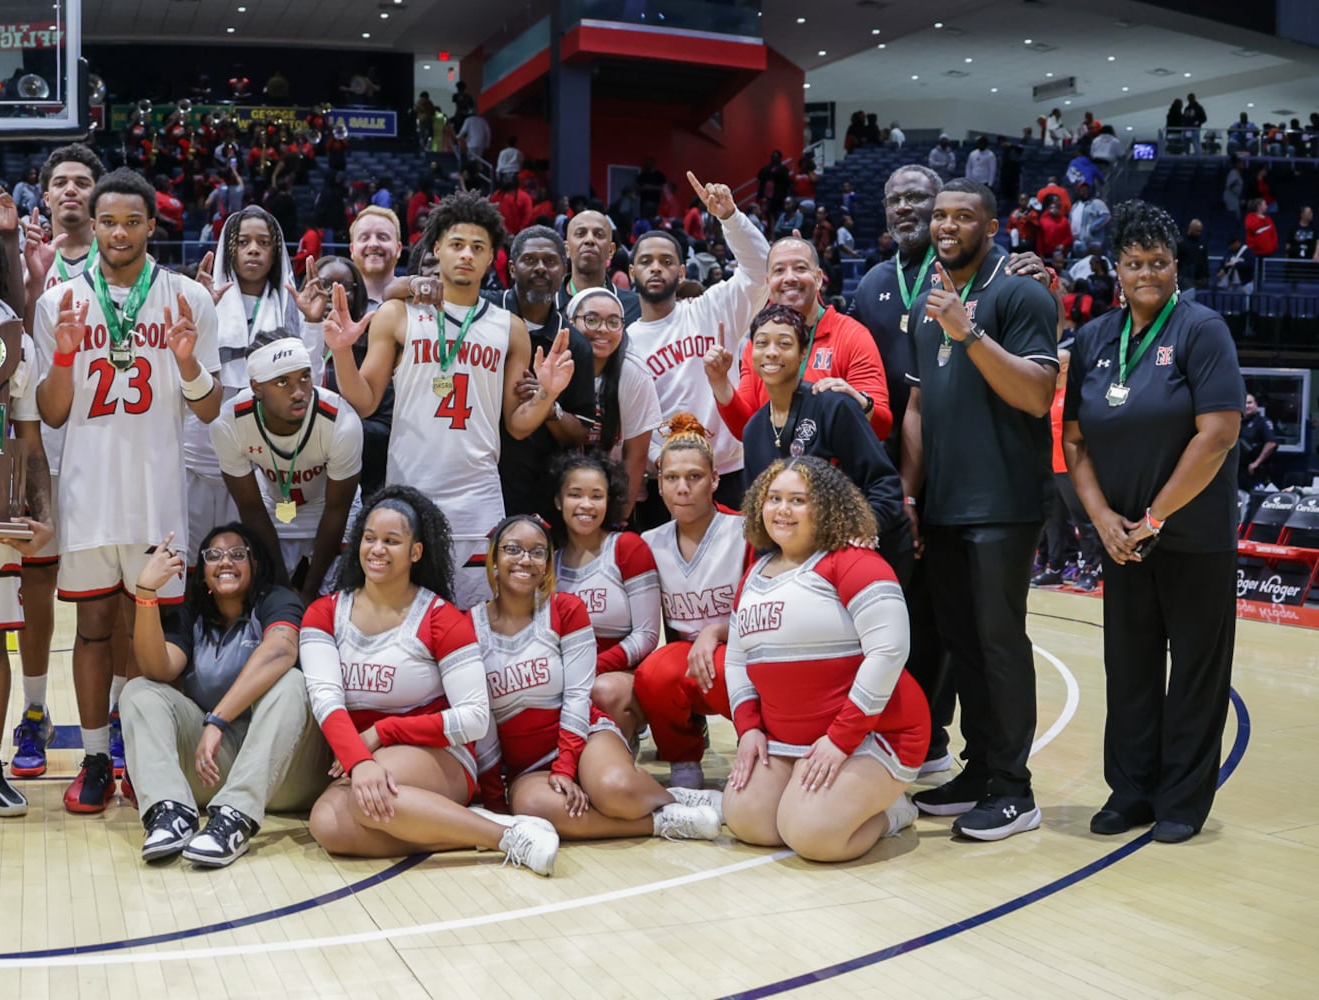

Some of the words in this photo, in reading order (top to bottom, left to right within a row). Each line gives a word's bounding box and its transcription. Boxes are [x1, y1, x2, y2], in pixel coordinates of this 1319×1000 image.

[87, 356, 153, 419] 23
[434, 372, 473, 430] 4
[661, 585, 735, 621] RAMS
[1259, 575, 1300, 603] Kroger
[738, 601, 785, 638] RAMS
[340, 661, 396, 694] RAMS
[486, 657, 551, 699] RAMS
